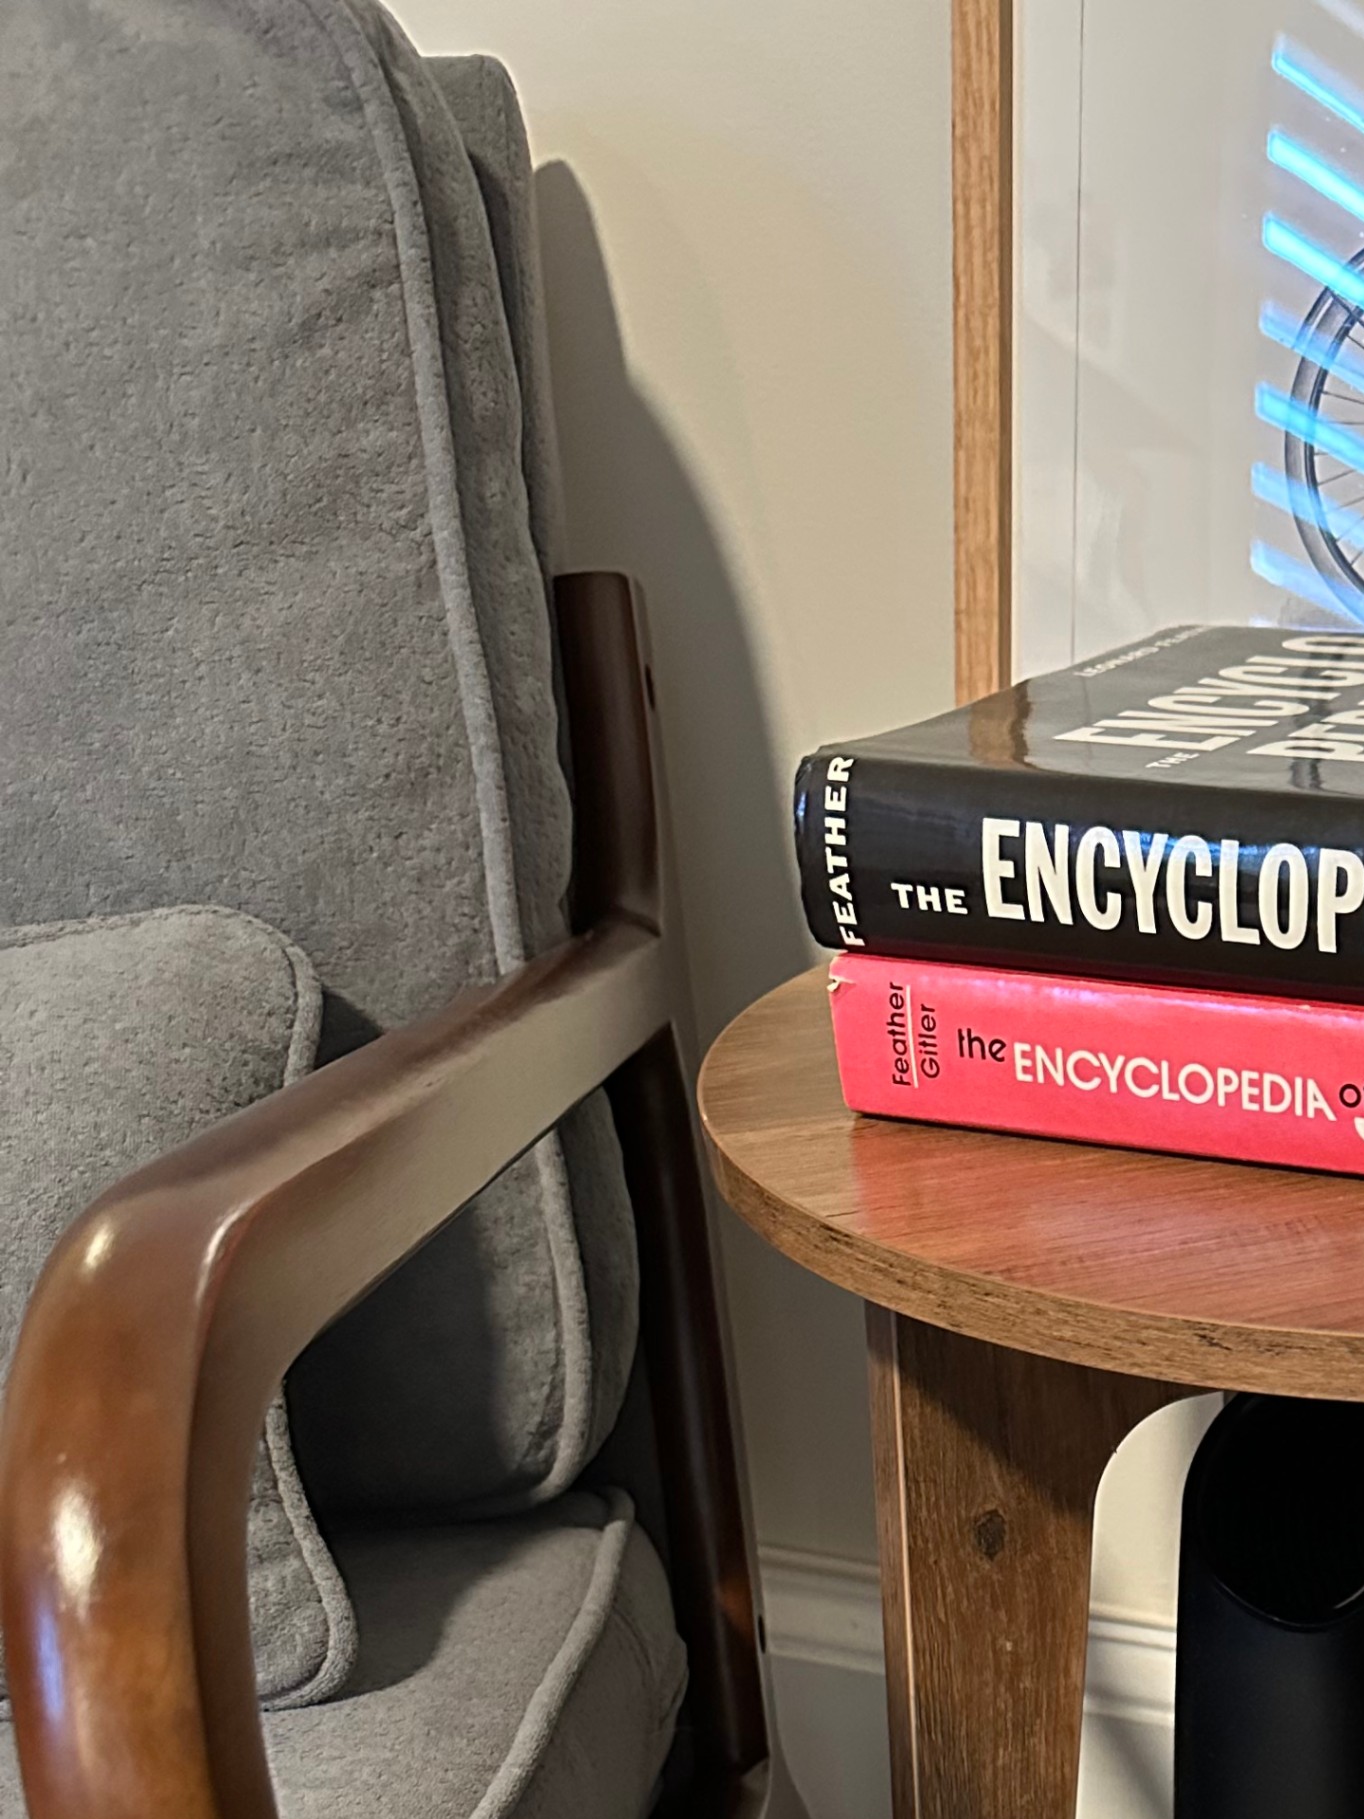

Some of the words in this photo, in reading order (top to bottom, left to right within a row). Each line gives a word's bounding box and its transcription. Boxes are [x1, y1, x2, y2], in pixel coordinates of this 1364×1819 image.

[1146, 752, 1201, 770] THE
[824, 756, 866, 946] FEATHER
[890, 882, 969, 915] THE
[886, 980, 912, 1084] Feather
[919, 1003, 940, 1079] Gitler
[957, 1027, 1007, 1063] the
[1013, 1042, 1337, 1123] ENCYCLOPEDIA
